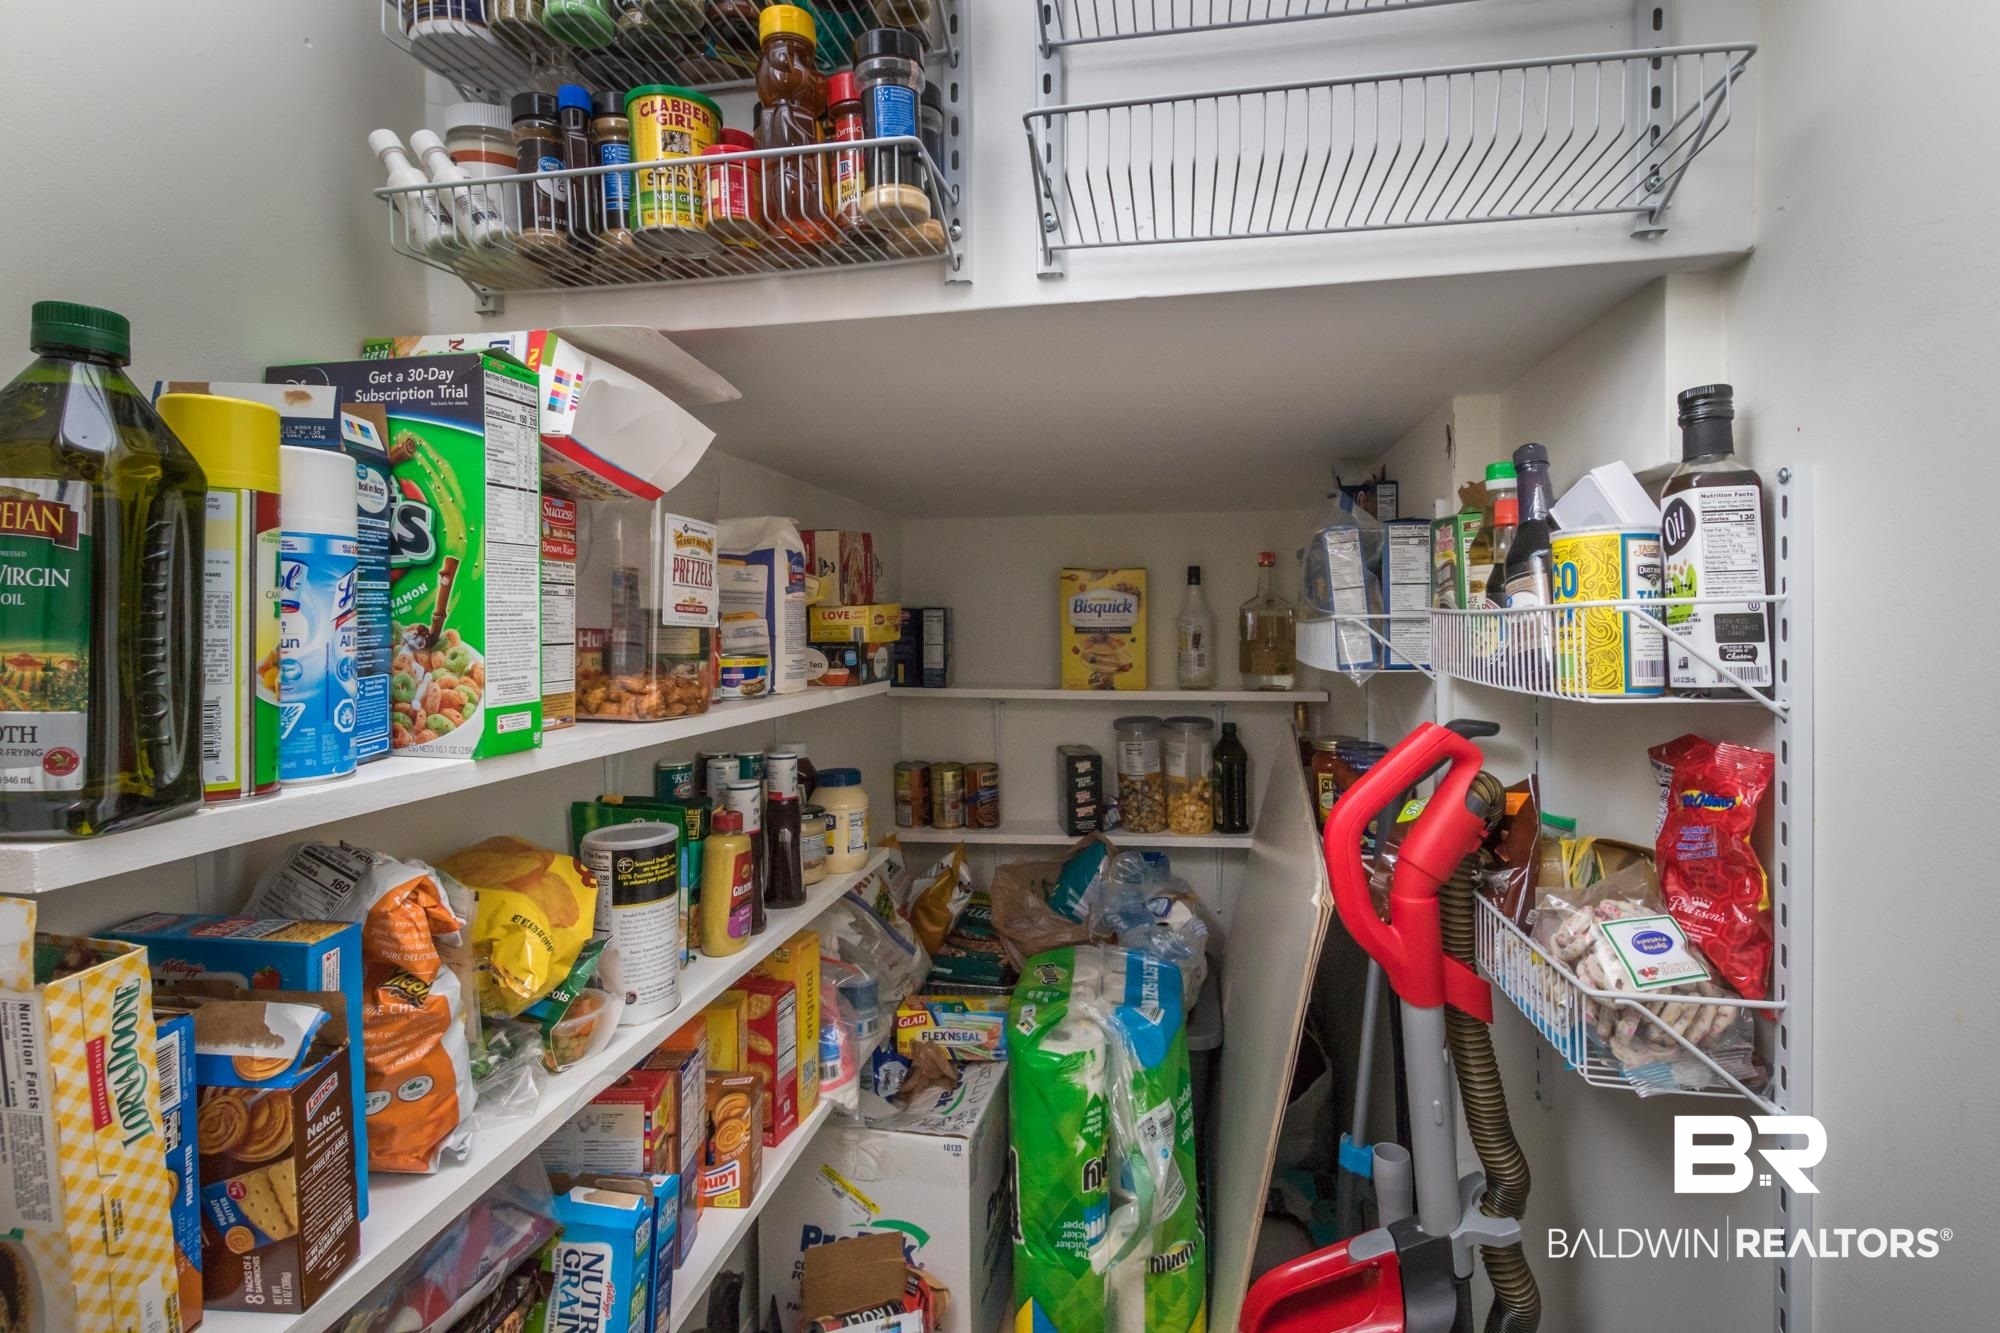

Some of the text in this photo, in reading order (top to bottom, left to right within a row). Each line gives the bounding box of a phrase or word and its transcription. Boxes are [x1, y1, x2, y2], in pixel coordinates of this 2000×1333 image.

[640, 99, 710, 128] CLABBER
[656, 113, 695, 130] GIRL
[369, 367, 454, 384] Get a 30-Day
[355, 384, 468, 403] Subscription Trial
[543, 501, 574, 520] Success
[542, 541, 574, 555] Brown Rice
[672, 556, 713, 587] PRETZELS
[2, 593, 25, 605] OIL
[1073, 598, 1132, 618] Bisquick
[822, 611, 850, 620] LOVE
[809, 660, 823, 668] Tea
[4, 776, 18, 784] 946
[329, 877, 351, 894] 160
[511, 914, 522, 924] NET
[805, 969, 815, 1040] original
[898, 1015, 926, 1027] GLAD
[19, 1002, 40, 1110] Nutrition Facts
[307, 1077, 337, 1113] Lance
[306, 1106, 342, 1140] Nekot
[312, 1133, 350, 1176] PHILIP LANCE
[184, 1143, 194, 1207] PEANUT BUTTER
[252, 1255, 262, 1293] SANDWICHES
[245, 1294, 266, 1305] 8
[581, 1250, 605, 1333] NUTR
